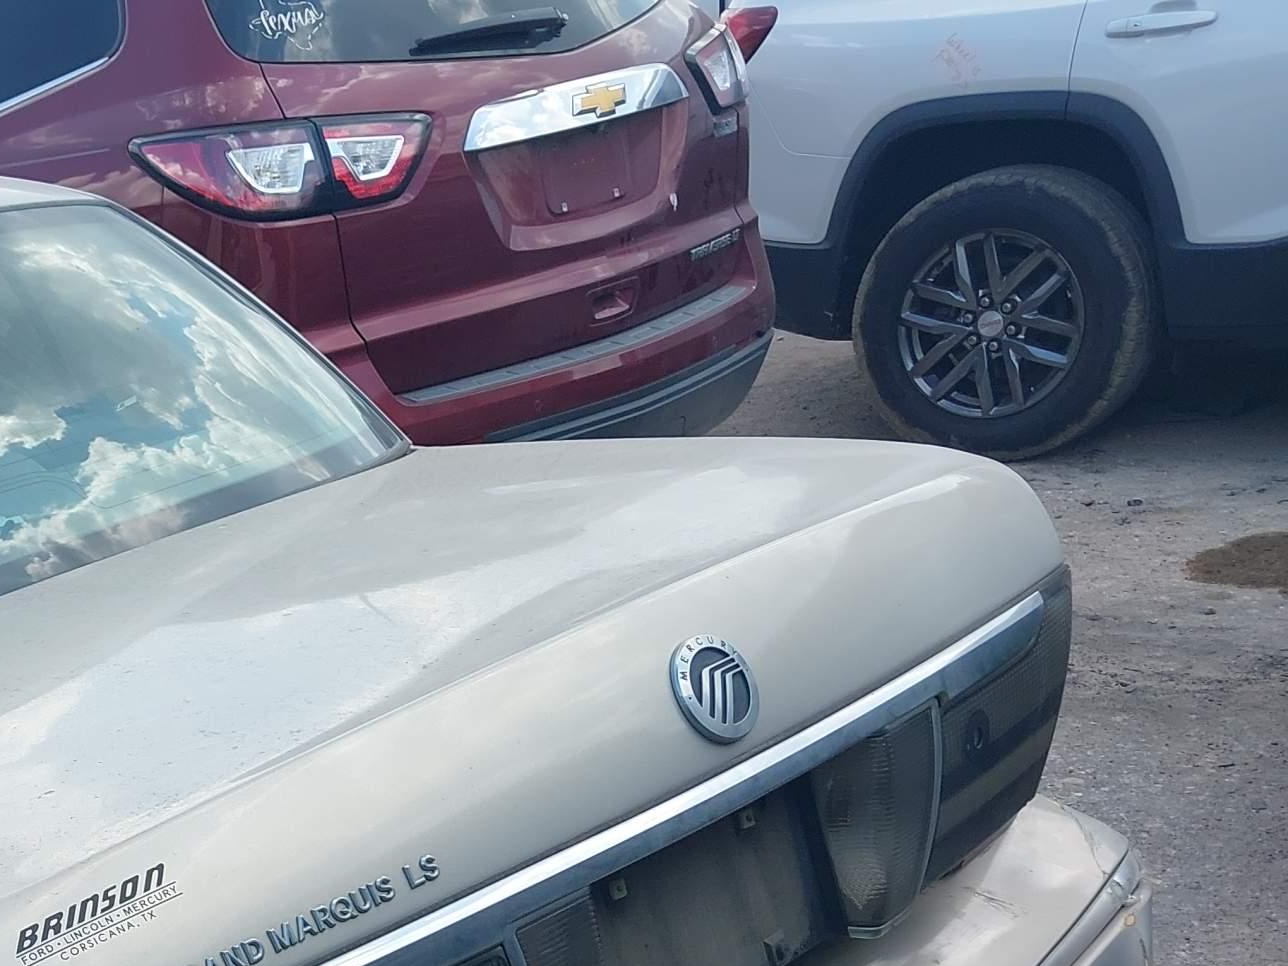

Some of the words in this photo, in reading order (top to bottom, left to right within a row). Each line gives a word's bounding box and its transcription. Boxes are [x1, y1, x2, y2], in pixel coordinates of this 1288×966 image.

[679, 635, 738, 681] MERCURY
[21, 944, 55, 966] FORD
[64, 915, 114, 945] LINCOLN
[123, 885, 178, 916] MERCURY
[142, 910, 158, 923] TX
[266, 875, 396, 953] MARQUIS
[402, 854, 441, 890] LS
